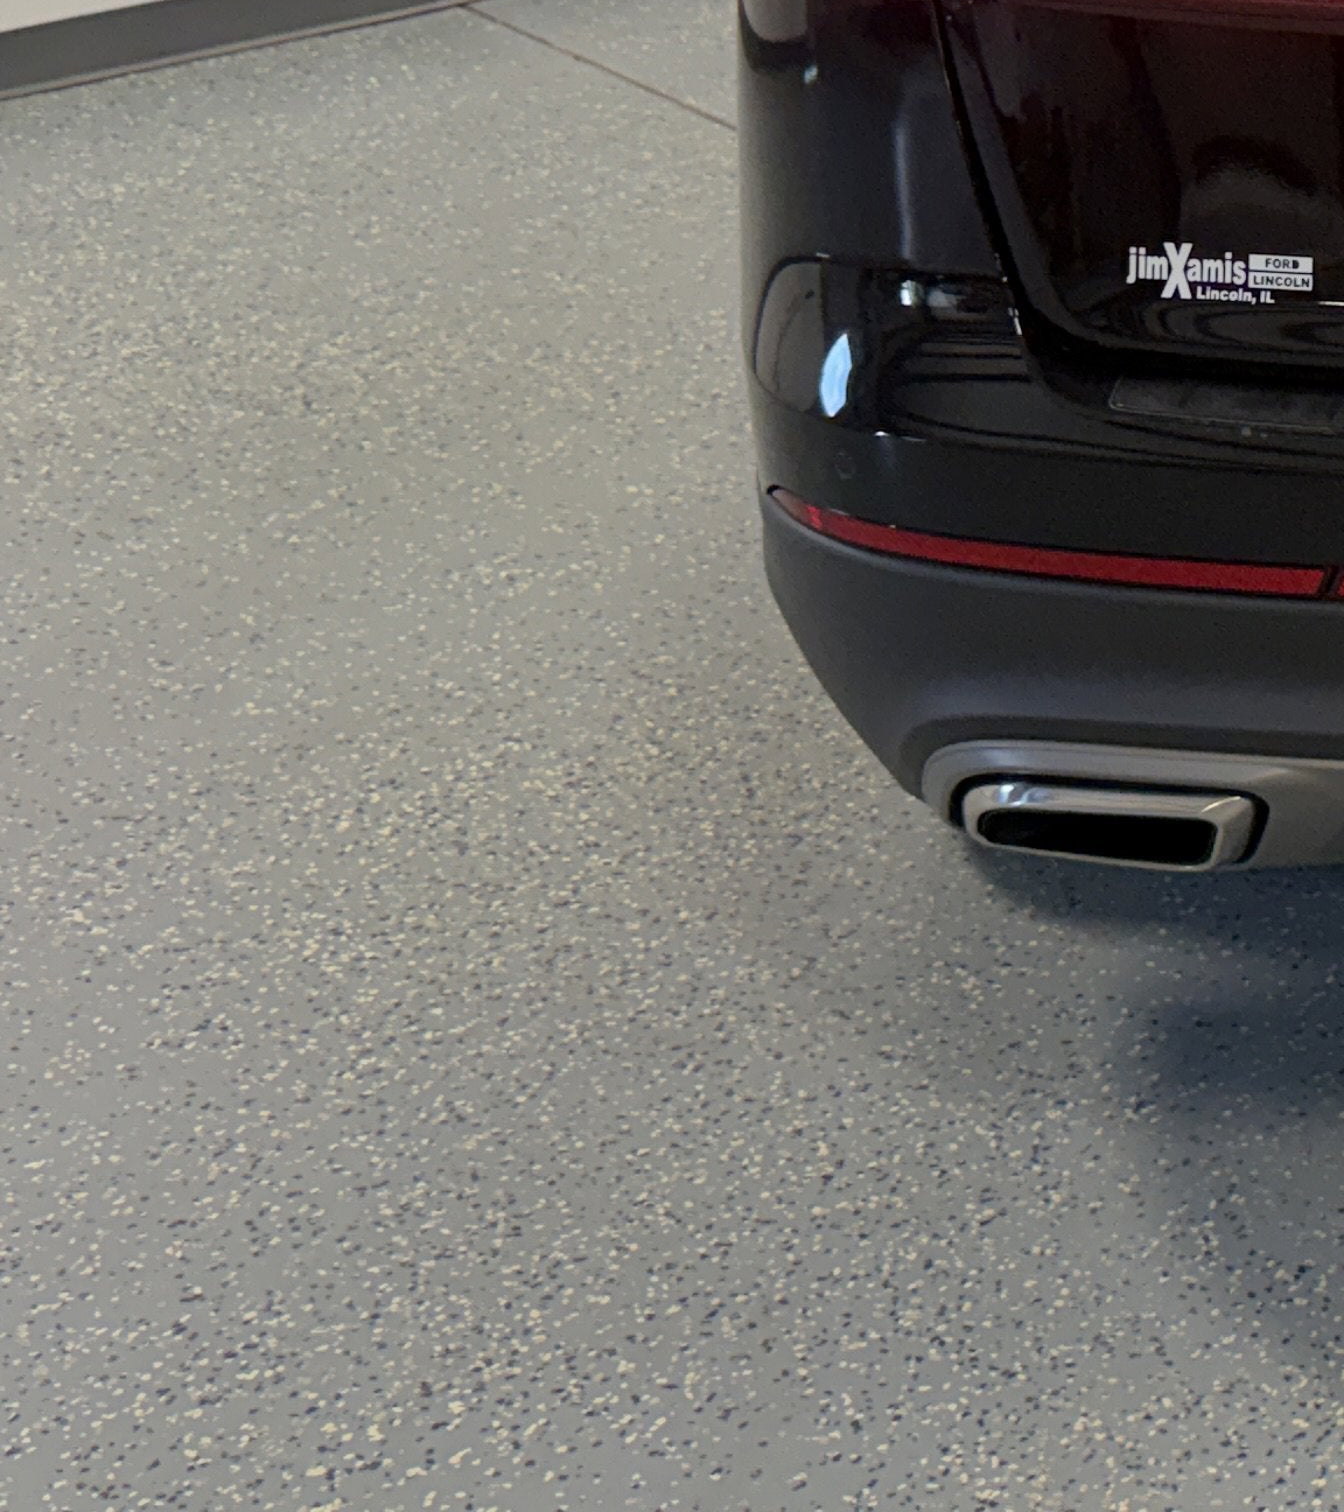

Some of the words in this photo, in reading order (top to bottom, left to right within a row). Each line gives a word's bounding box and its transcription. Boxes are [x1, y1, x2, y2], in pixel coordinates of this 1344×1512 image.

[1265, 258, 1299, 269] FORD
[1253, 277, 1310, 288] LINCOLN
[1197, 287, 1256, 305] Lincoln,
[1260, 291, 1275, 304] IL
